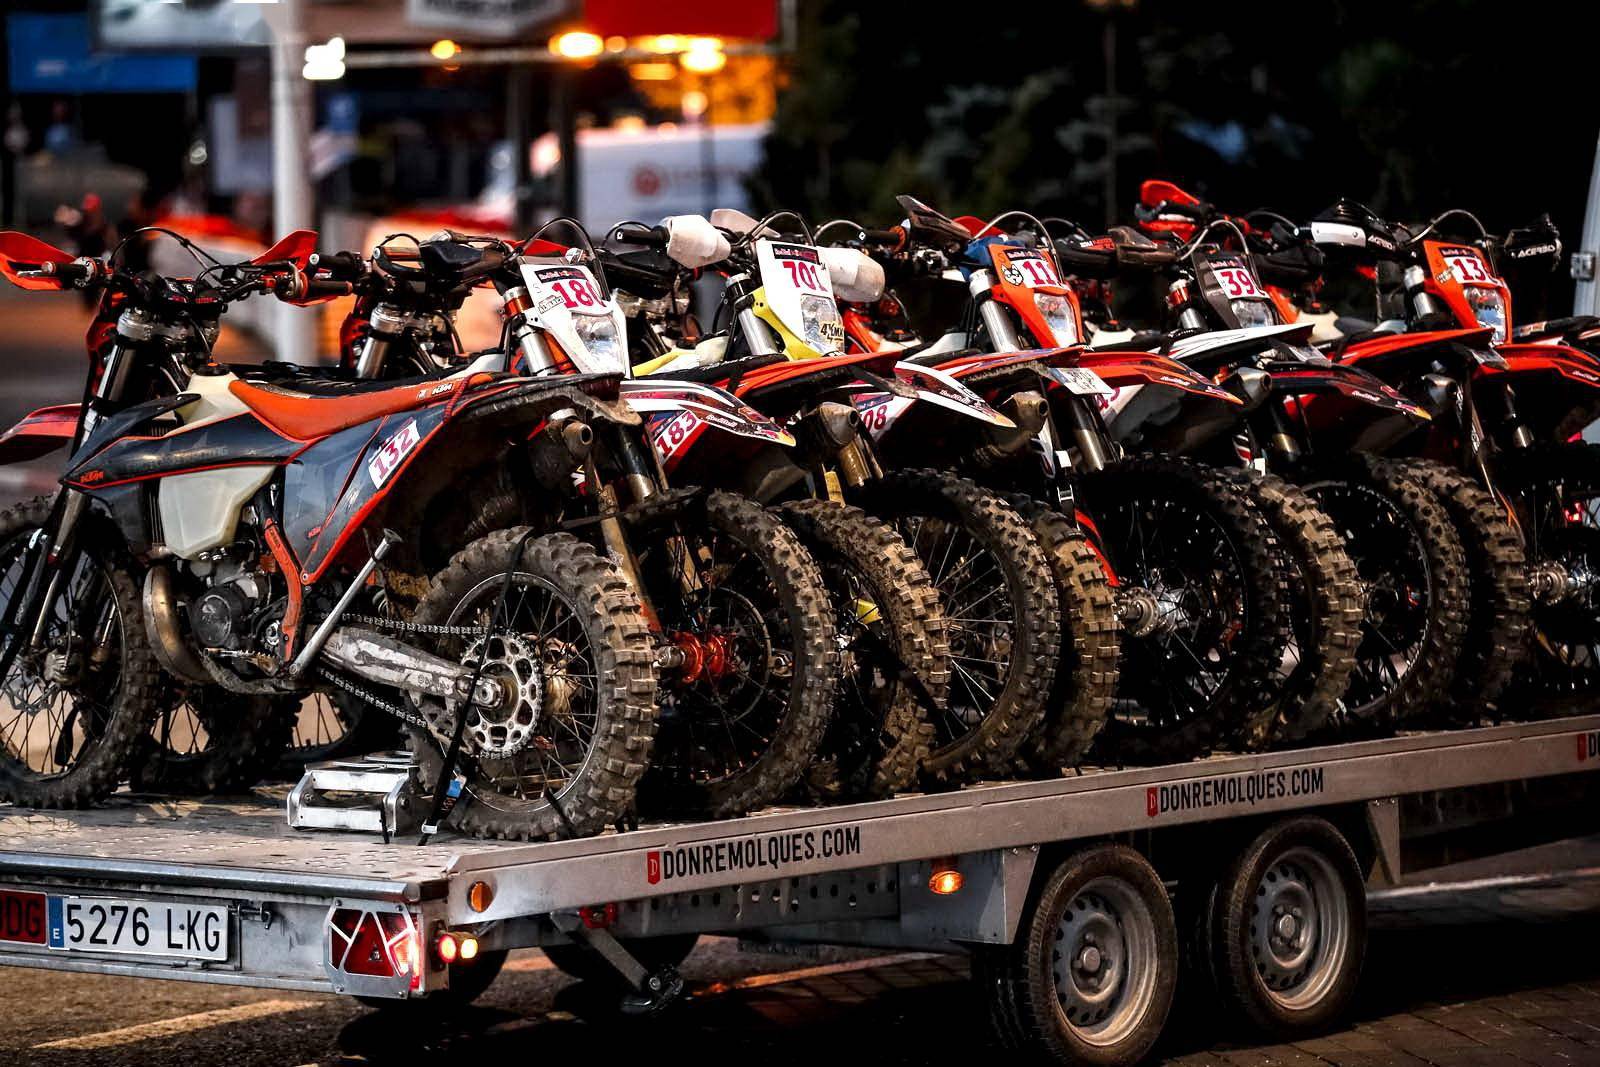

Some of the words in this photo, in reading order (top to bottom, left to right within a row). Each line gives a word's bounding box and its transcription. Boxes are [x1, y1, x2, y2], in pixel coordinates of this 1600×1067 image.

[782, 261, 828, 292] 701
[374, 428, 413, 480] 132
[656, 411, 697, 457] 183
[1160, 767, 1323, 813] DONREMOLQUES.COM
[663, 826, 861, 880] DONREMOLQUES.COM
[0, 895, 41, 937] DG
[66, 904, 150, 946] 5276
[167, 908, 220, 952] LKG
